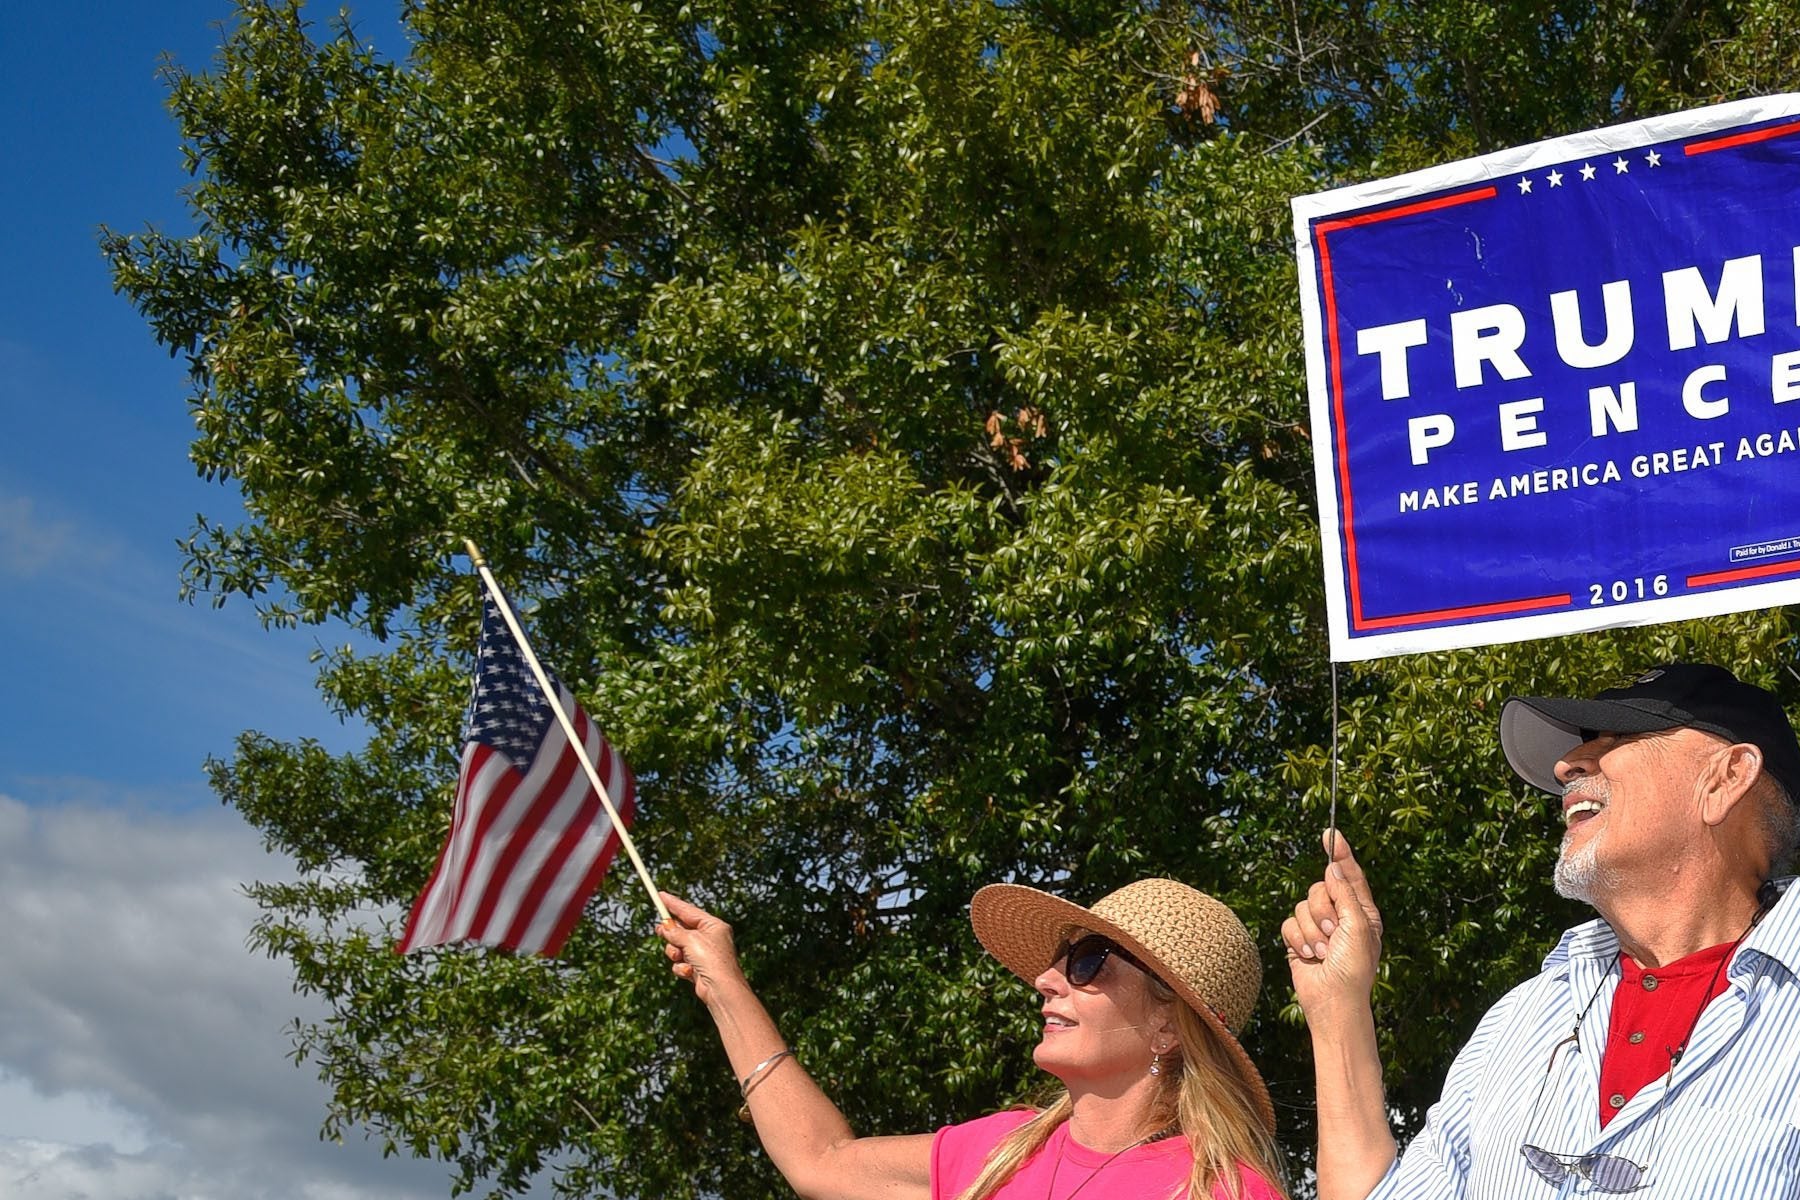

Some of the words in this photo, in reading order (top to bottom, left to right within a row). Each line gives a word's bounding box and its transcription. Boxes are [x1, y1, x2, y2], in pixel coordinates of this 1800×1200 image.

[1399, 481, 1479, 513] MAKE
[1488, 460, 1622, 500] AMERICA
[1631, 441, 1725, 478] GREAT
[1735, 547, 1748, 558] Paid
[1749, 547, 1757, 556] for
[1757, 546, 1765, 554] by
[1766, 541, 1788, 552] Donald
[1589, 574, 1668, 605] 2016
